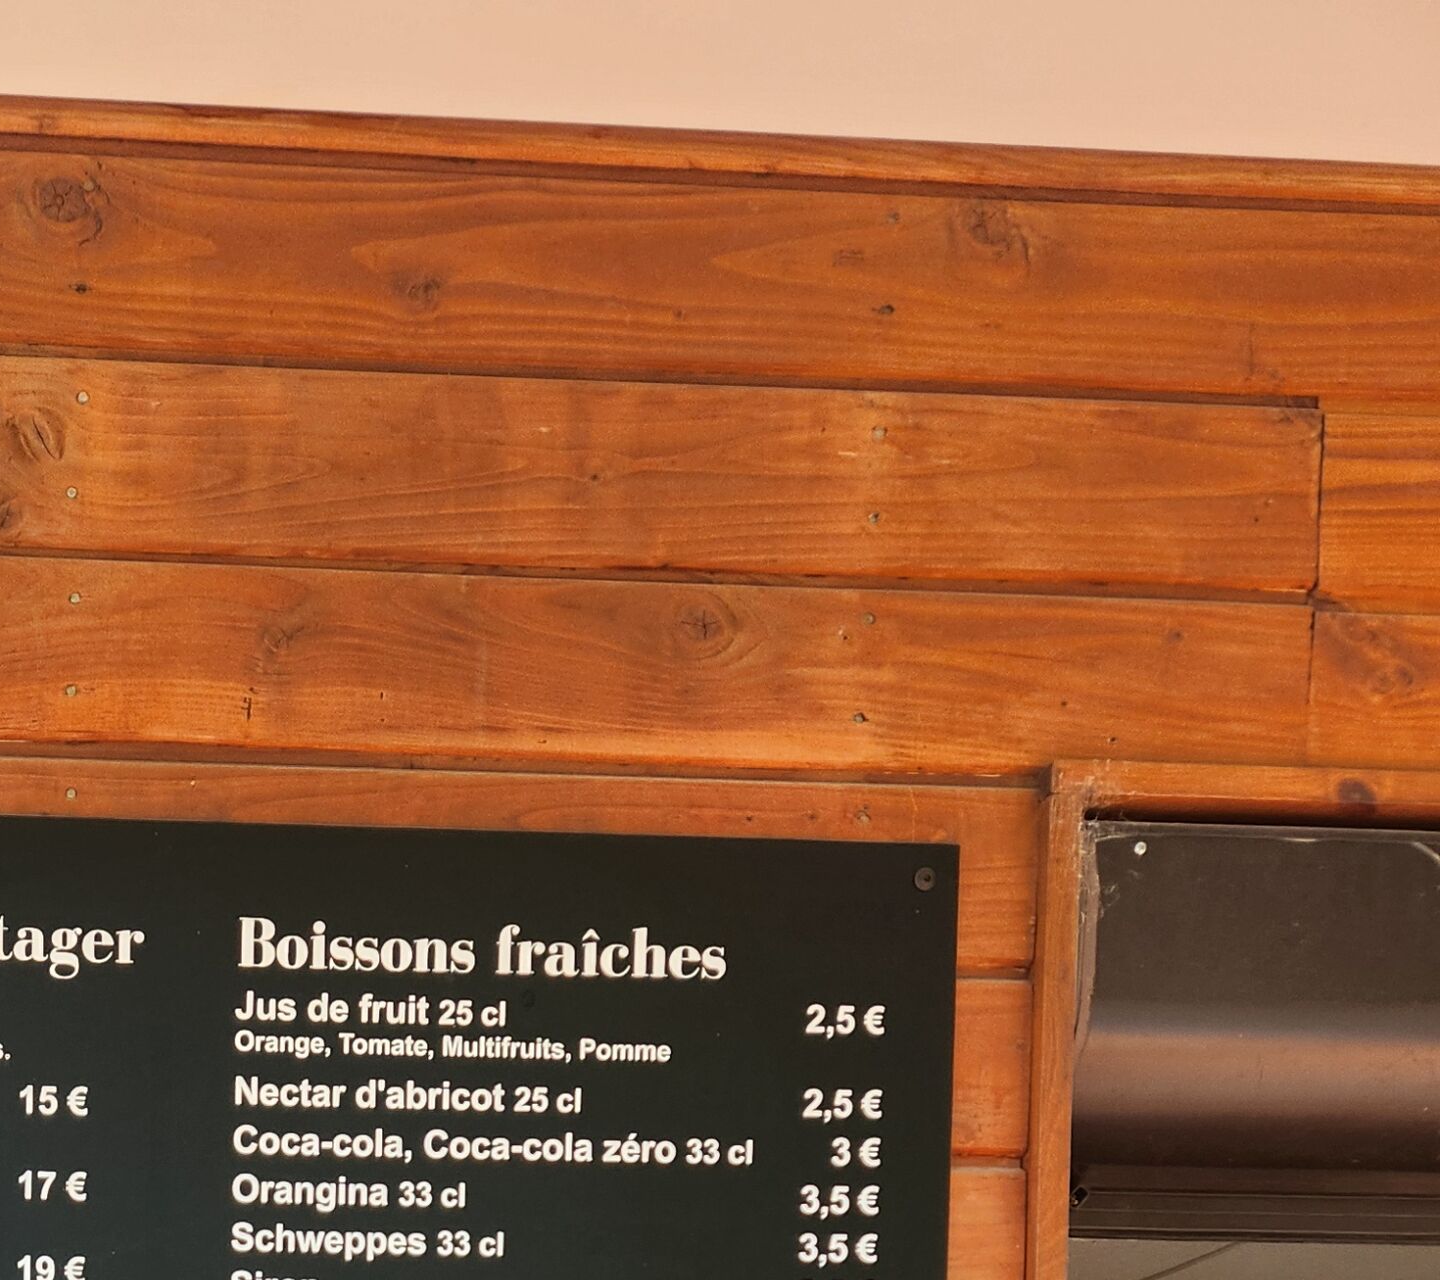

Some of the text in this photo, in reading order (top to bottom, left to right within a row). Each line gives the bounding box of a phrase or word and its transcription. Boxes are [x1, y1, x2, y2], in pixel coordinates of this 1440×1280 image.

[237, 916, 727, 981] Boissons fraîches
[234, 989, 507, 1028] Jus de fruit 25 cl
[234, 1029, 672, 1064] Orange, Tomate, Multifruits, Pomme
[234, 1074, 582, 1114] Nectar d'abricot 25 cl
[232, 1123, 754, 1166] Coca-cola, Coca-cola zéro 33 cl
[231, 1172, 466, 1214] Orangina 33 cl
